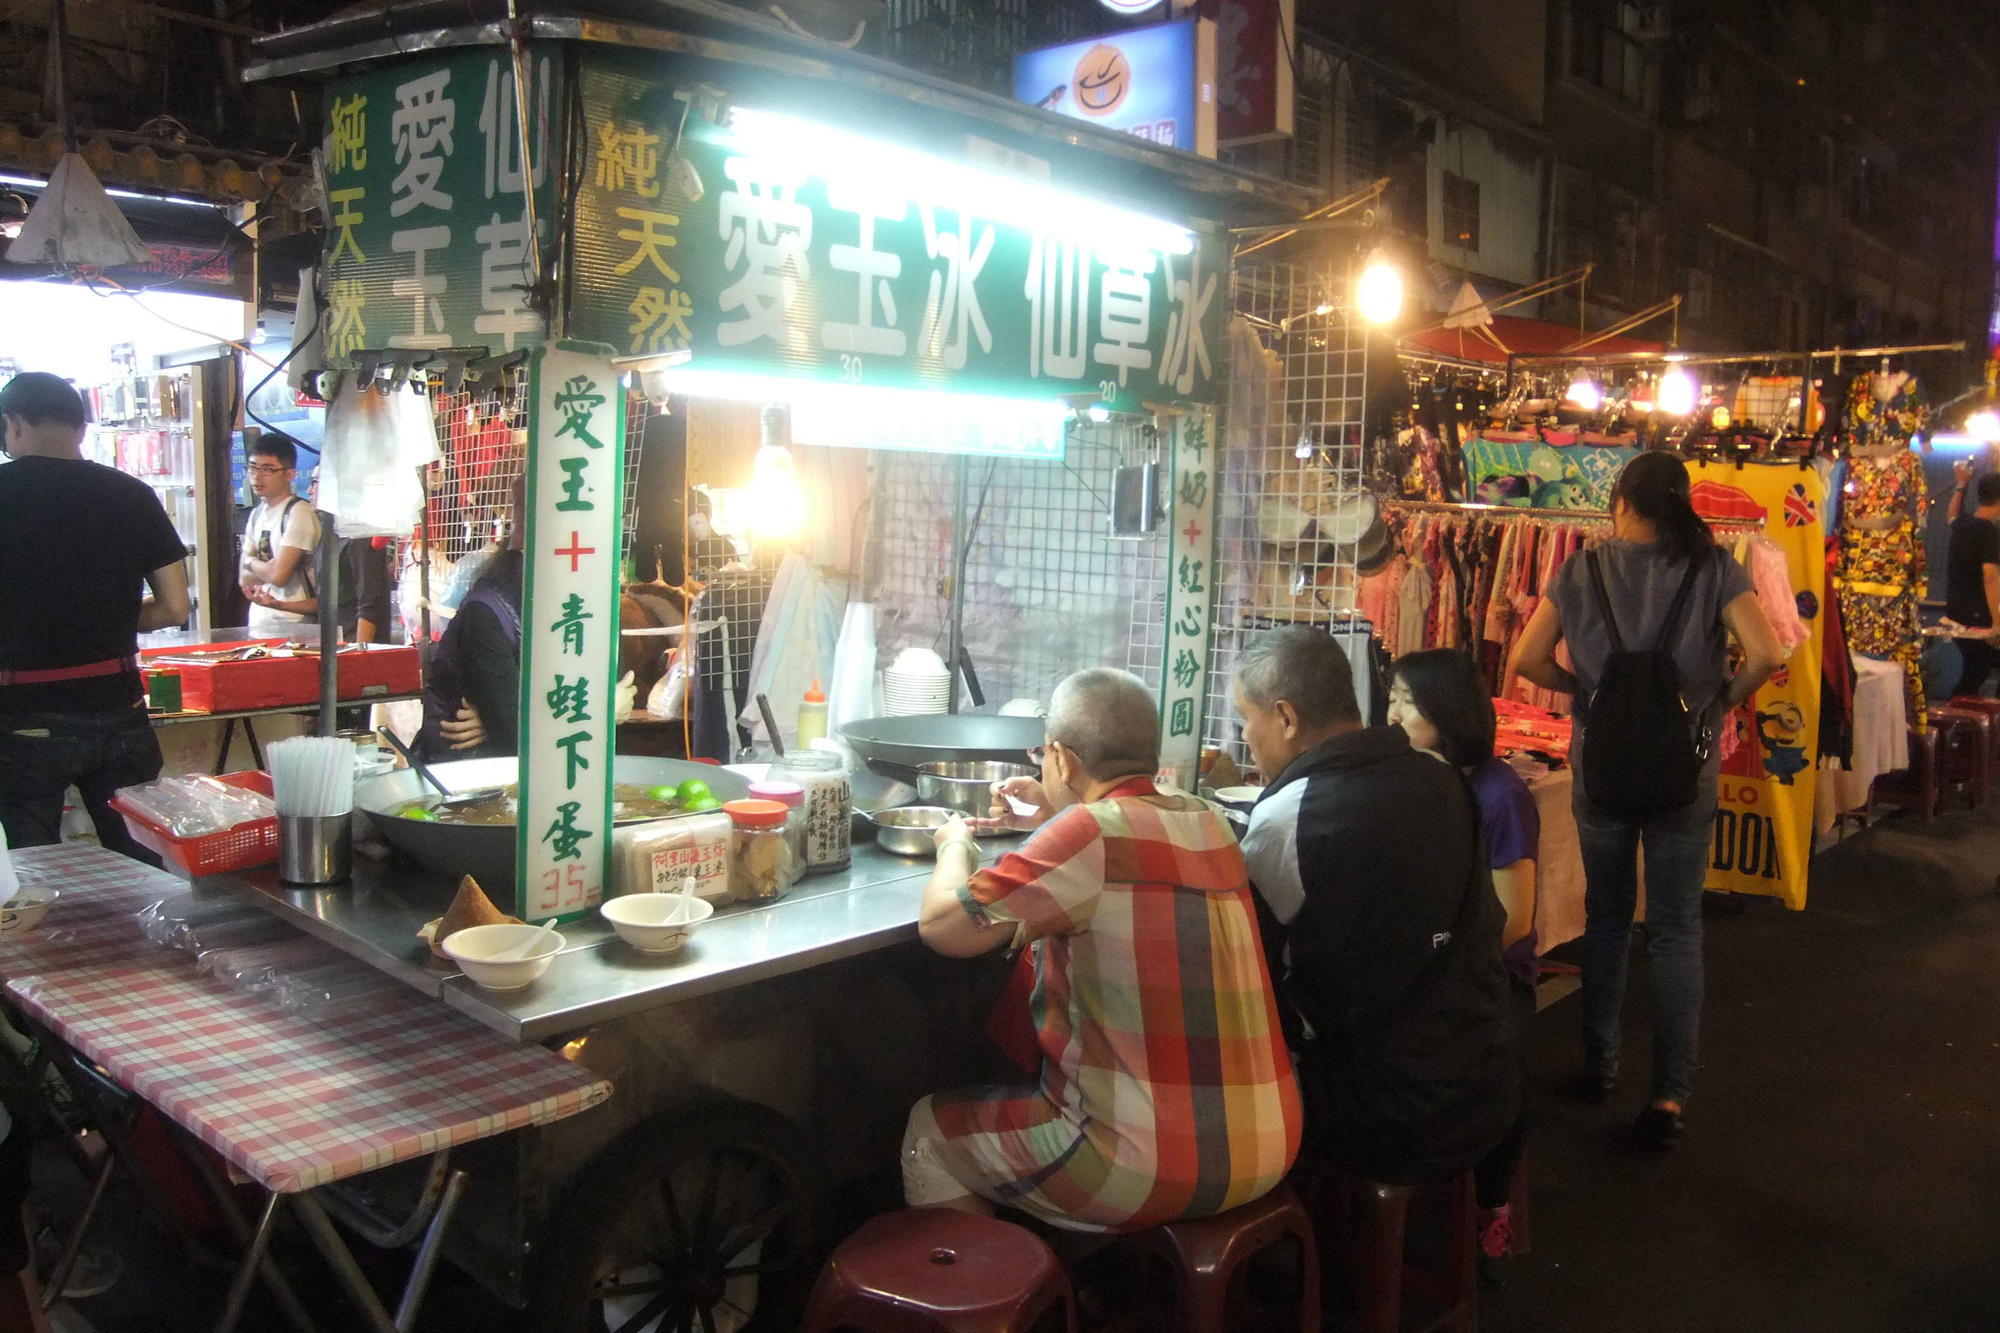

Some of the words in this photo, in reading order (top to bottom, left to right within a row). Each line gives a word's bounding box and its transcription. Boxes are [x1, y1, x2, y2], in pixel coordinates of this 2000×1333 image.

[329, 93, 367, 358] 純天然
[389, 67, 455, 348] 愛玉
[596, 121, 694, 354] 純天然
[840, 353, 864, 381] 30
[1099, 380, 1116, 402] 20
